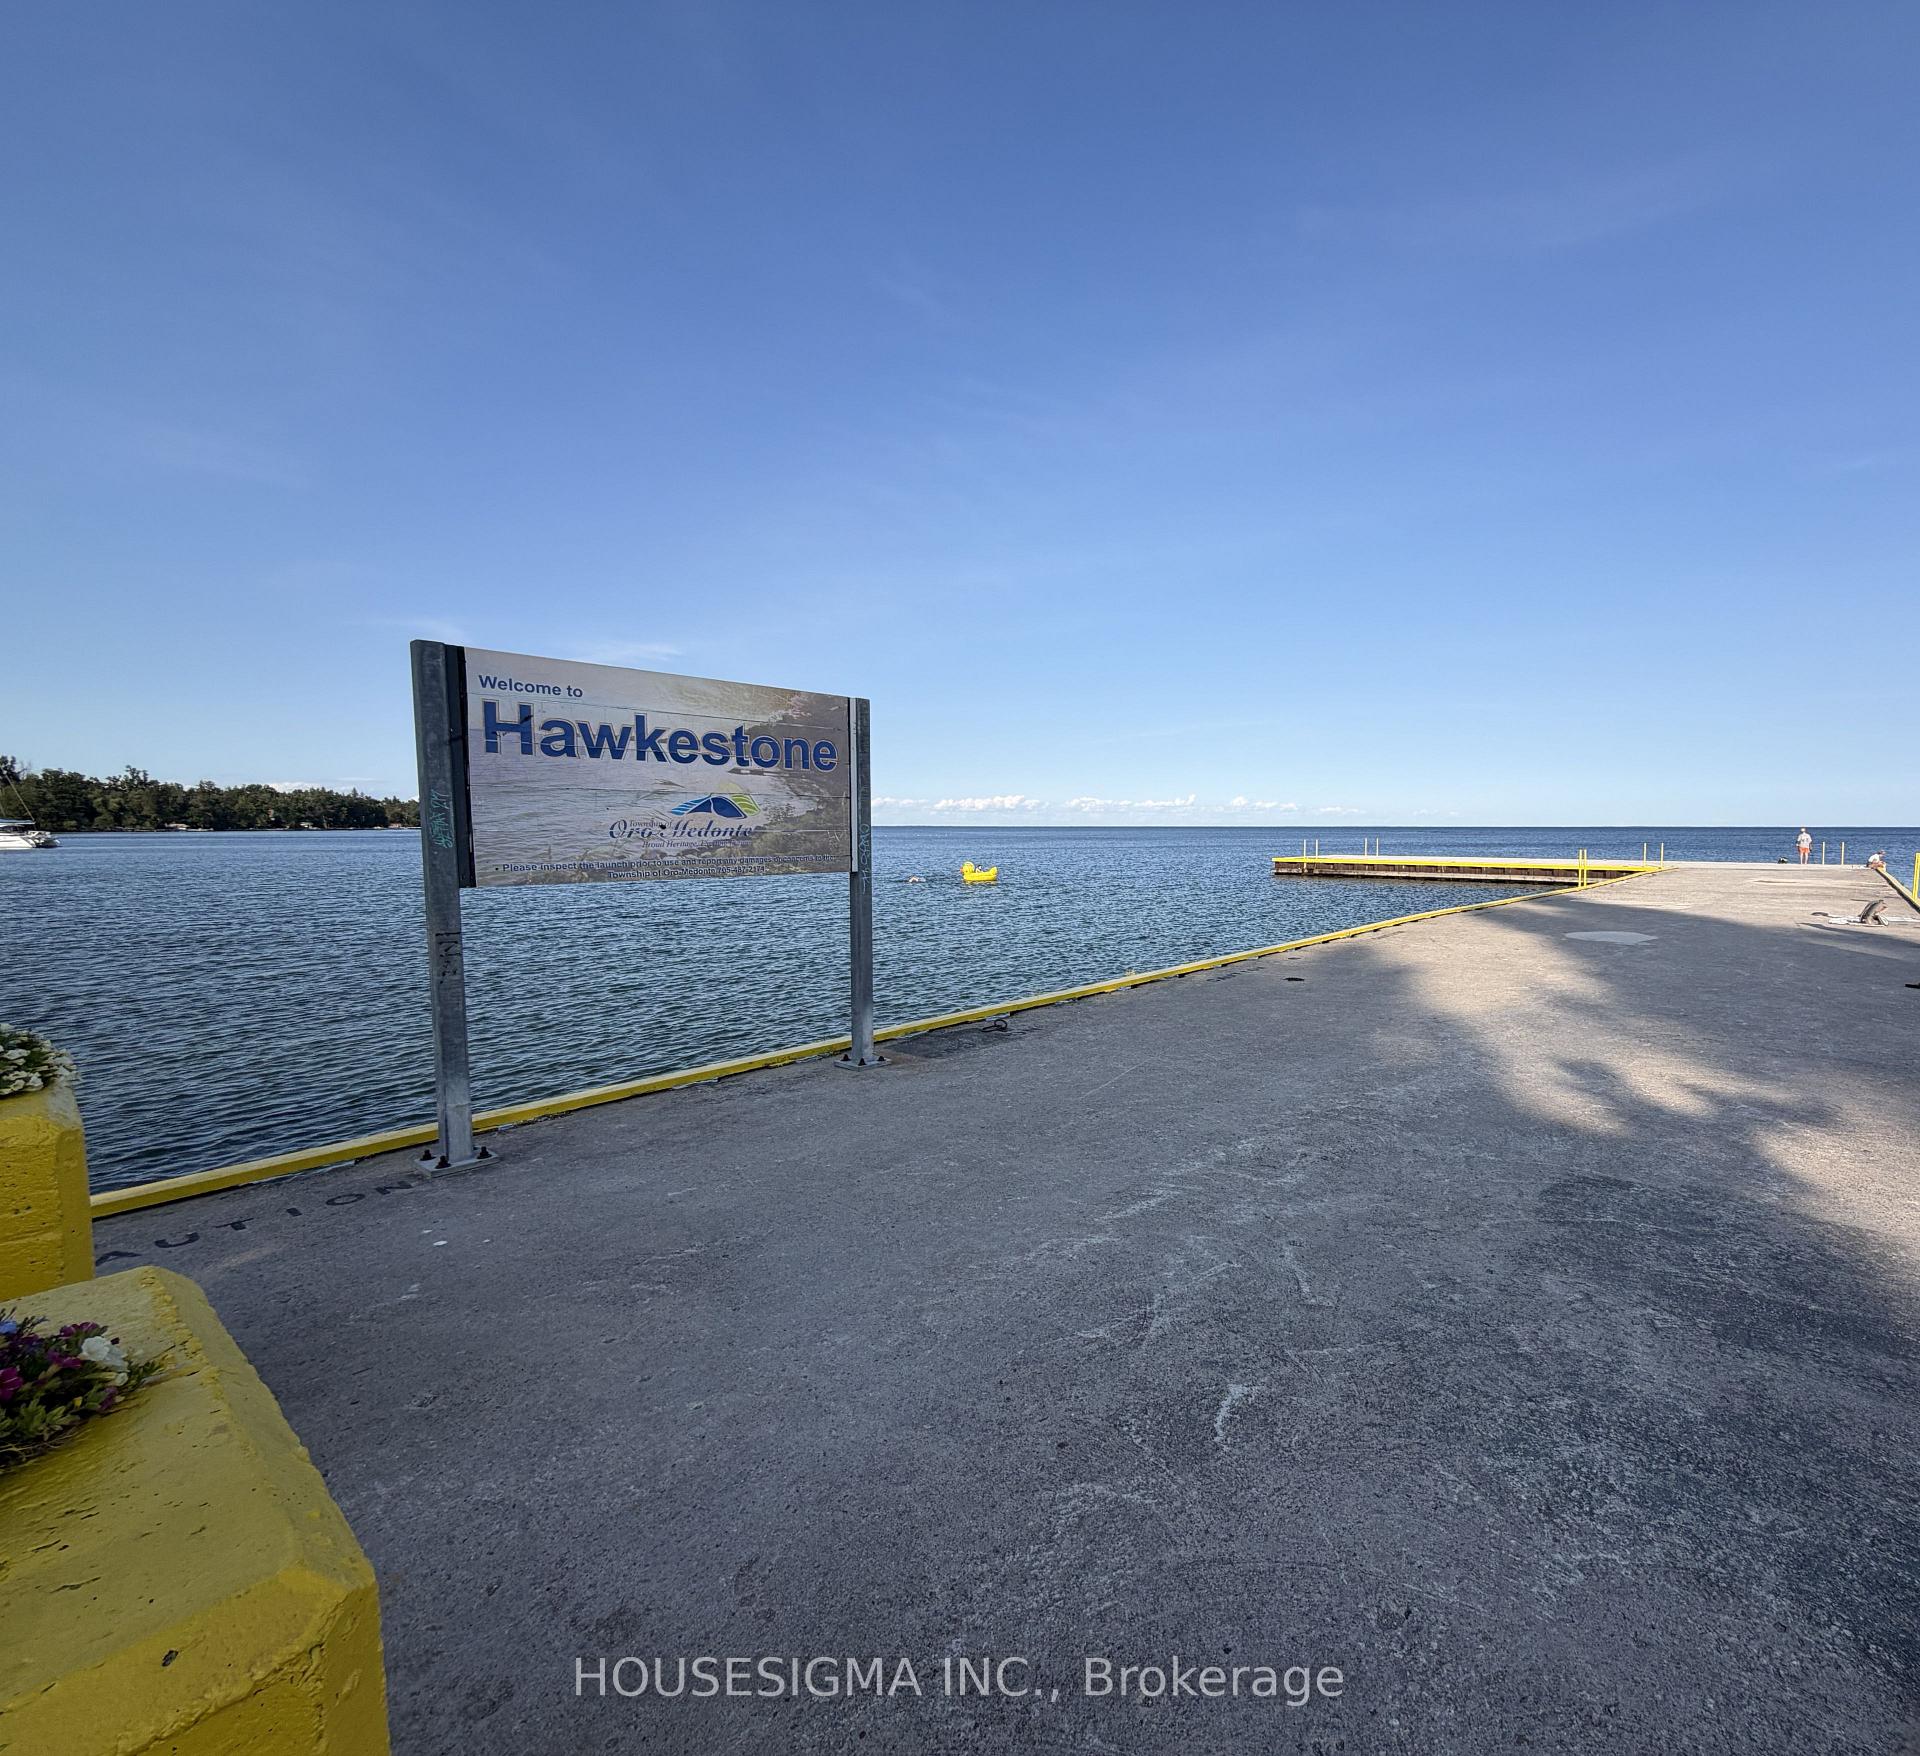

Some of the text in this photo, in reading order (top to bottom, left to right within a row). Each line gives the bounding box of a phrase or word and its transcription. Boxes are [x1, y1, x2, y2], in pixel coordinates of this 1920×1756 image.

[478, 675, 583, 698] Welcome to
[482, 699, 839, 772] Hawkestone
[502, 863, 537, 872] Please
[540, 862, 579, 873] inspect
[580, 861, 595, 870] the
[630, 859, 652, 869] prior
[653, 858, 662, 867] to
[664, 858, 679, 866] use
[682, 857, 697, 866] and
[699, 857, 721, 866] report
[723, 857, 738, 865] any
[740, 855, 773, 865] damages
[607, 870, 651, 879] Township
[653, 869, 662, 877] of
[663, 867, 717, 877] Oro-Medonte
[96, 1180, 413, 1267] AUTION
